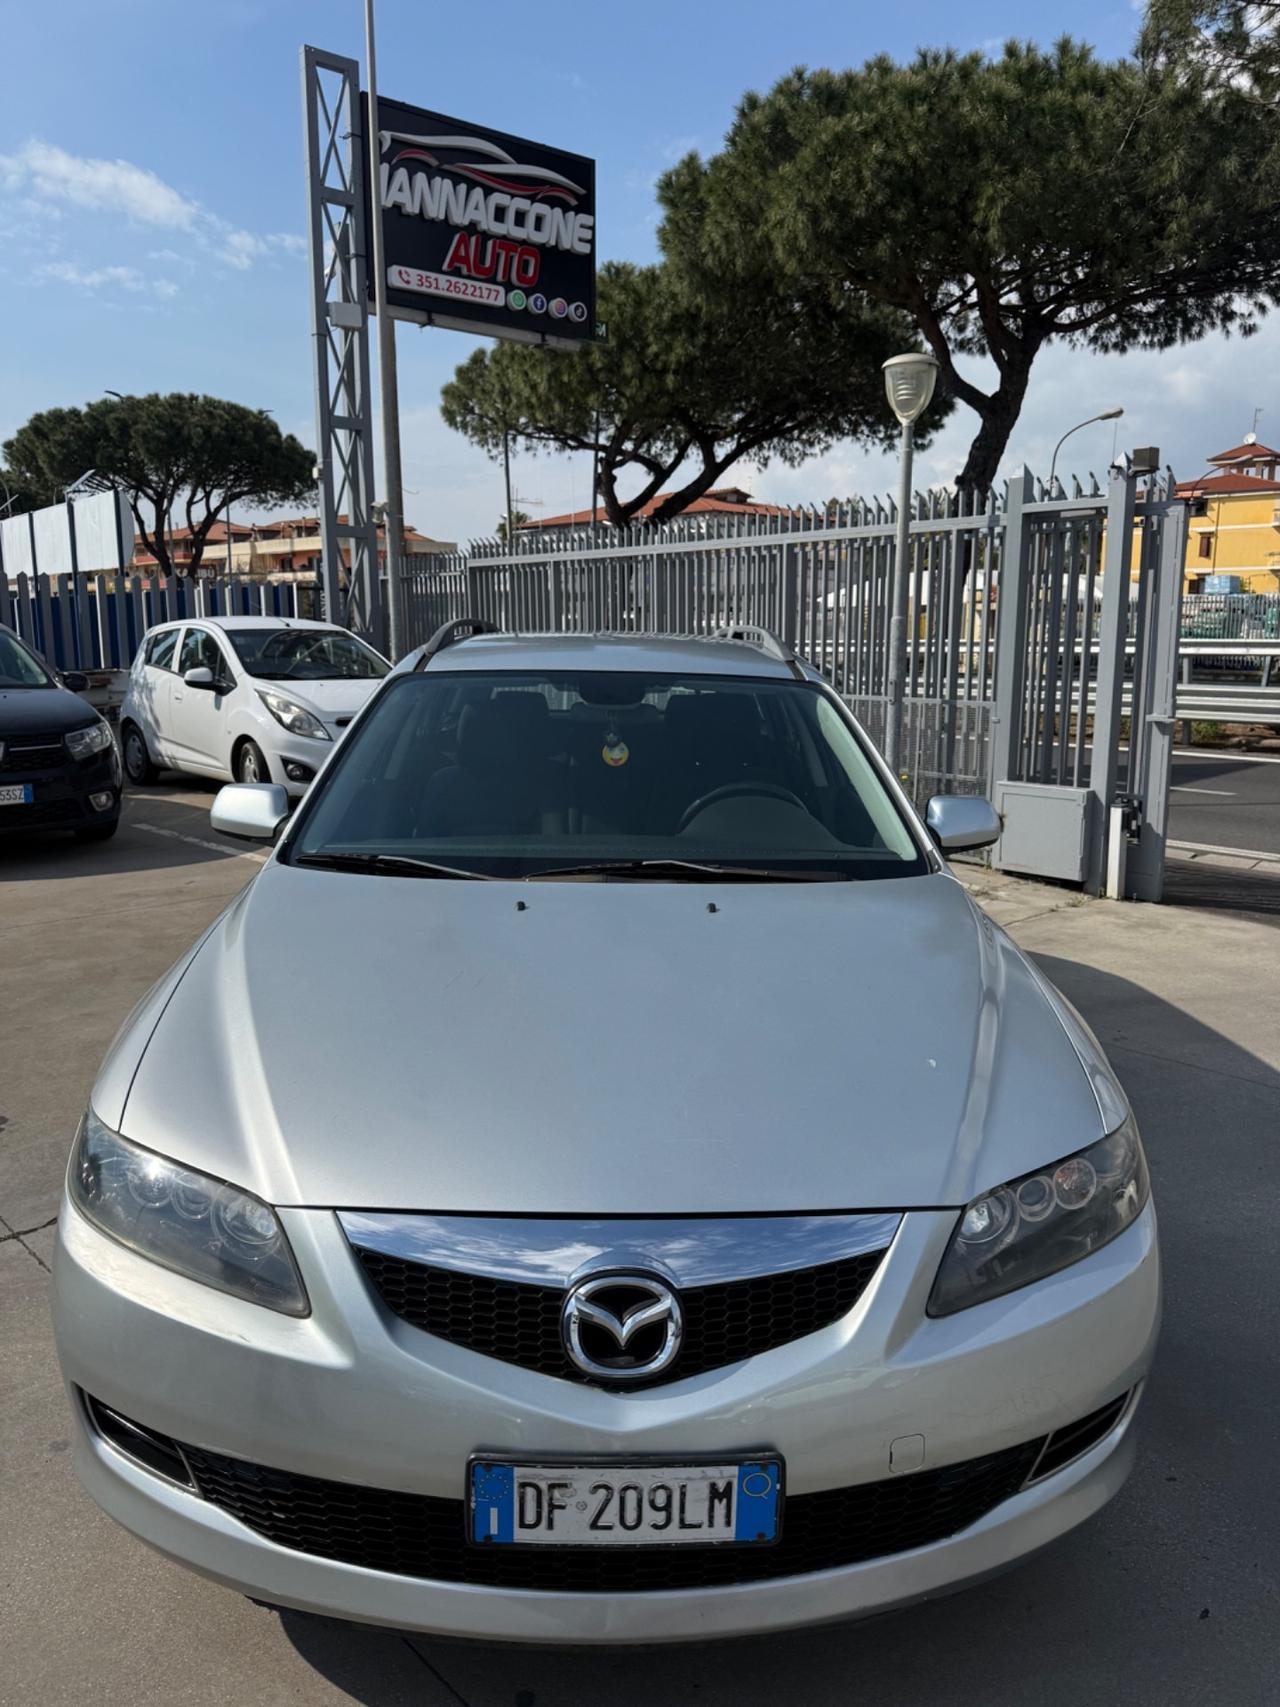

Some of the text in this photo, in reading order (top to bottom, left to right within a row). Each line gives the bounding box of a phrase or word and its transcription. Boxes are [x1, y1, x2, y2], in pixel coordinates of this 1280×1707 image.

[379, 162, 595, 255] IANNACCONE
[442, 231, 541, 288] AUTO
[416, 273, 501, 302] 351.2622177
[517, 1481, 570, 1531] DF
